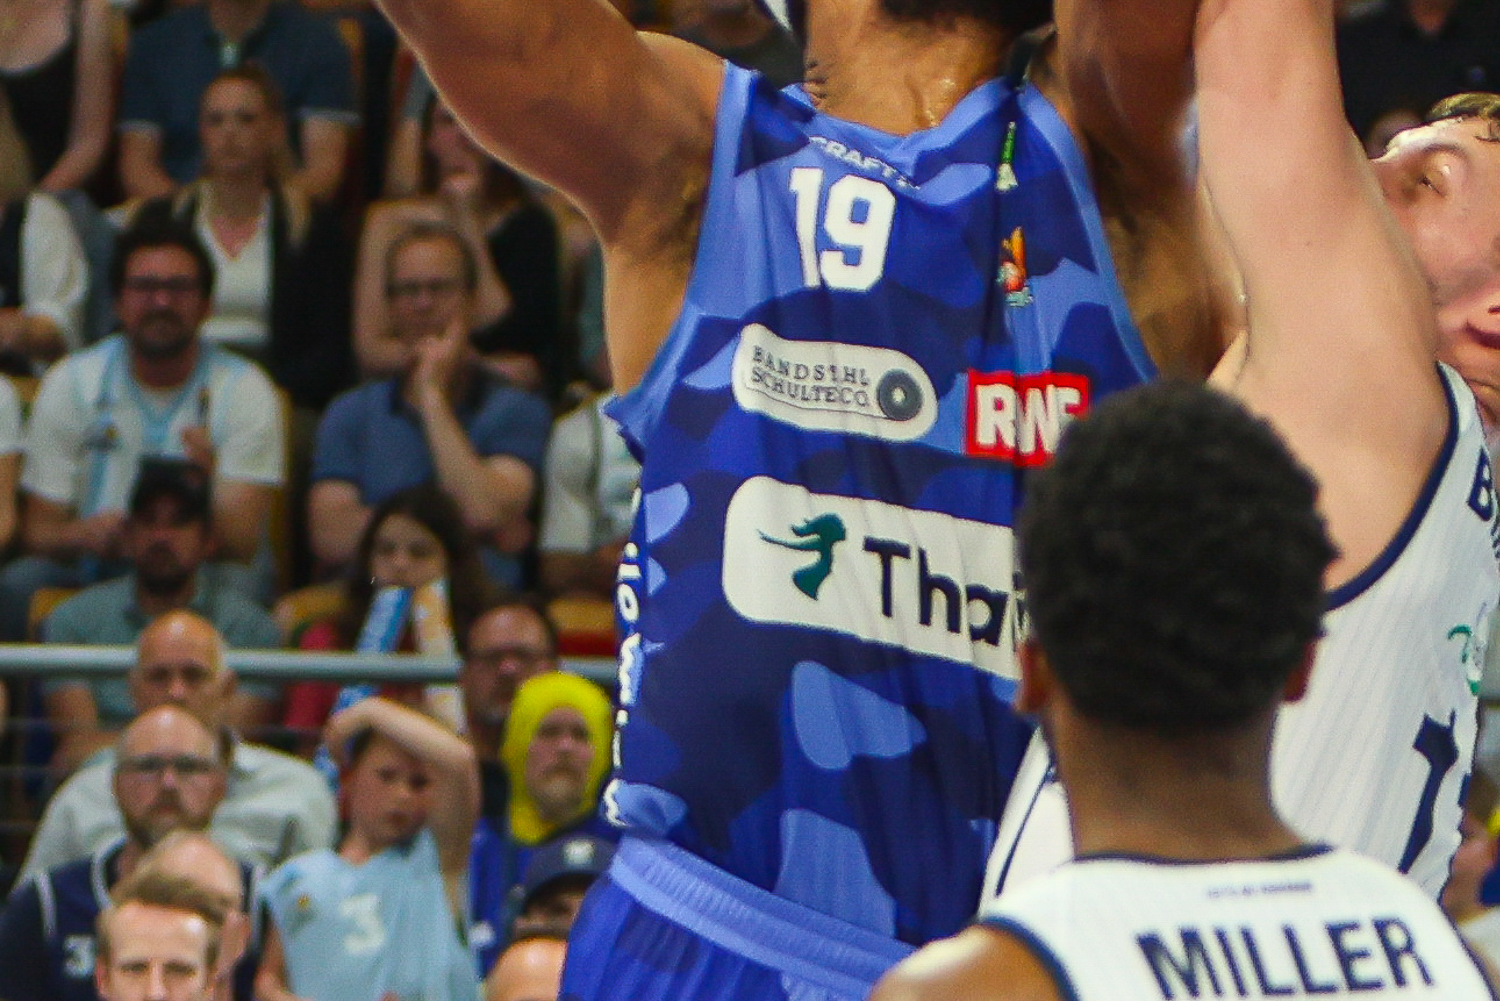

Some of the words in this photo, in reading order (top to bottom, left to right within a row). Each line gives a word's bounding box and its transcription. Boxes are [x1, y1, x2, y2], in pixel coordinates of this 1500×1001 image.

[789, 166, 896, 292] 19
[342, 894, 386, 955] 3
[1136, 915, 1433, 999] MILLER
